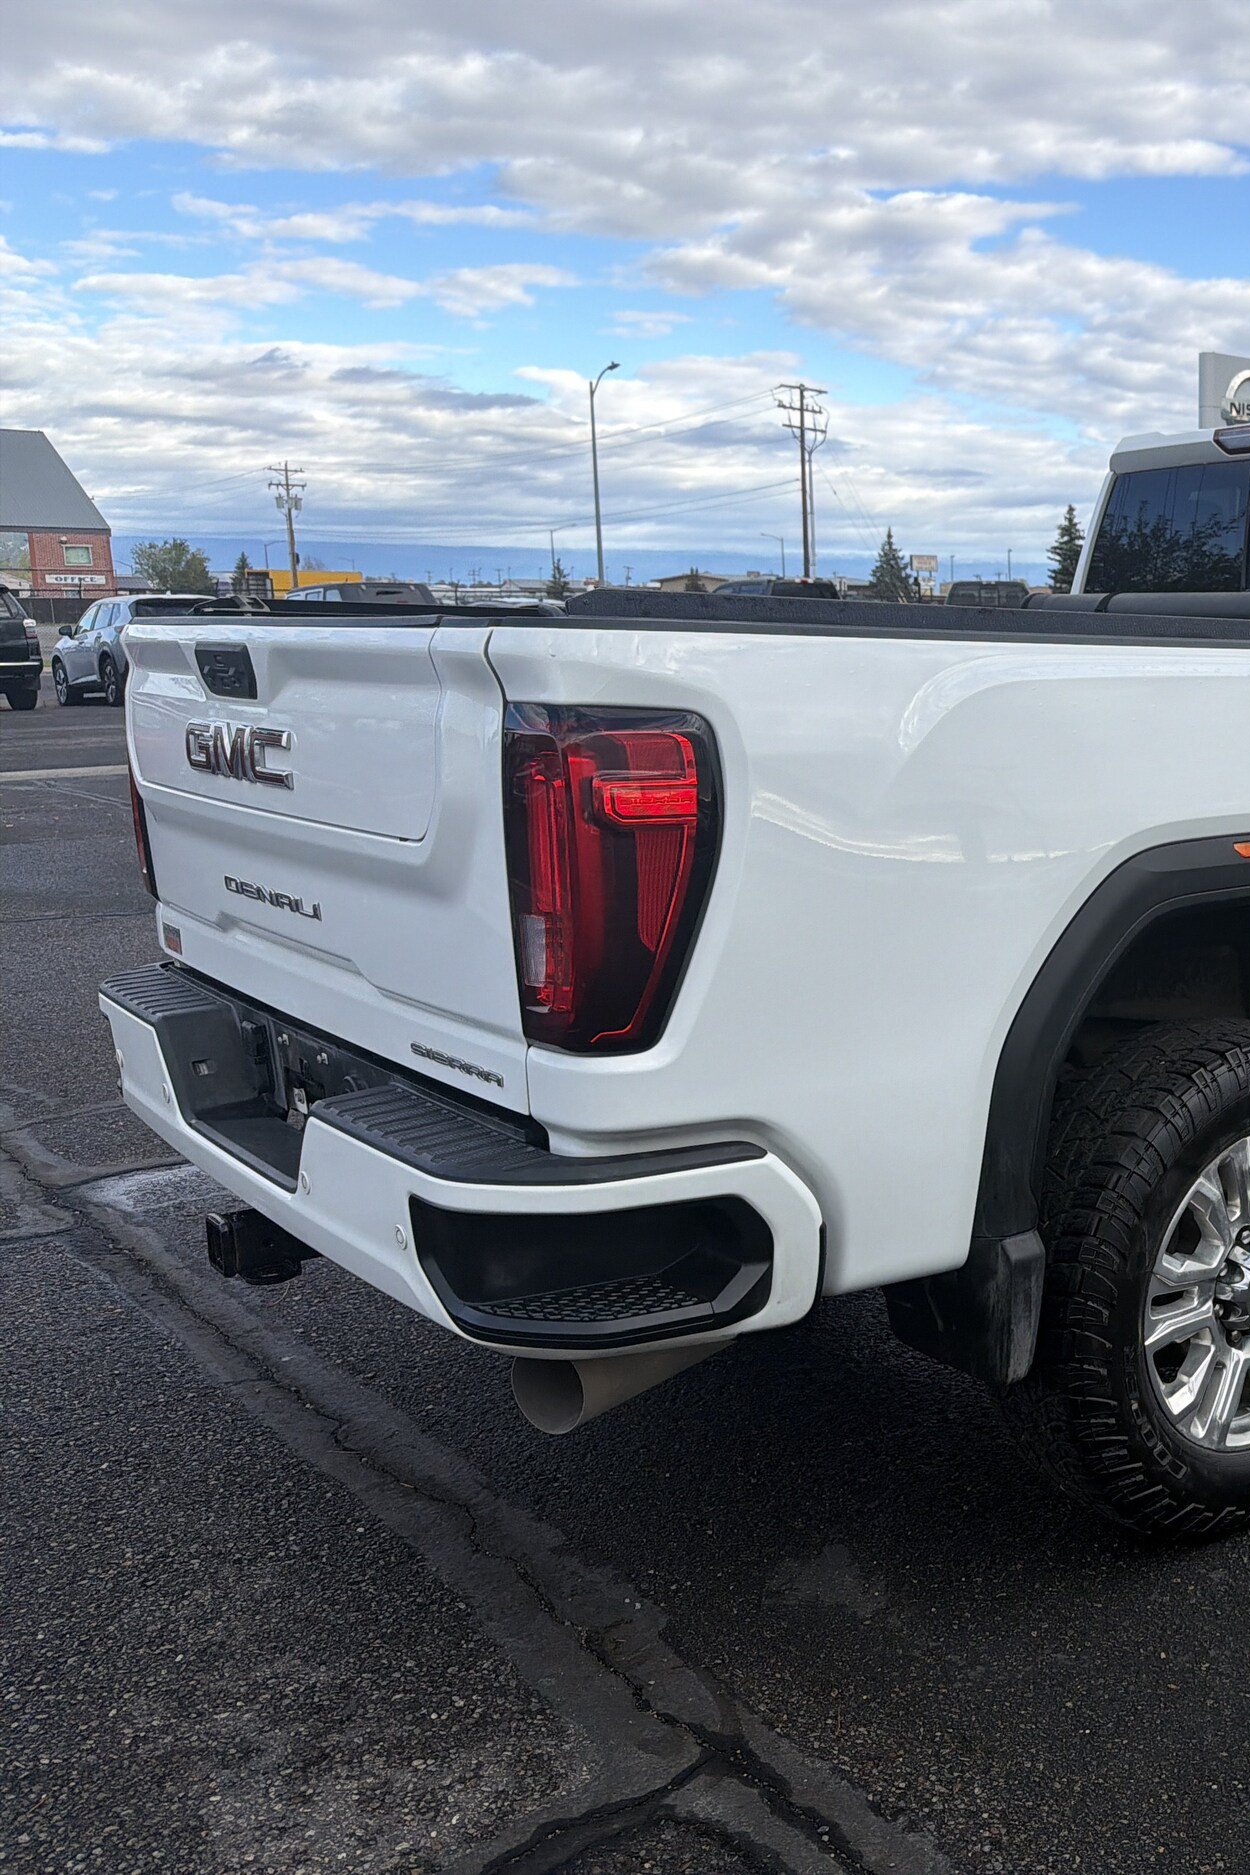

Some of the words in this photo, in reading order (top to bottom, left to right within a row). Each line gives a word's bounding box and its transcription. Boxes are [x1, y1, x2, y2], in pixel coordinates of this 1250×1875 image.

[185, 718, 294, 791] GMC
[223, 874, 323, 922] DENALI
[410, 1041, 505, 1088] SIERRA
